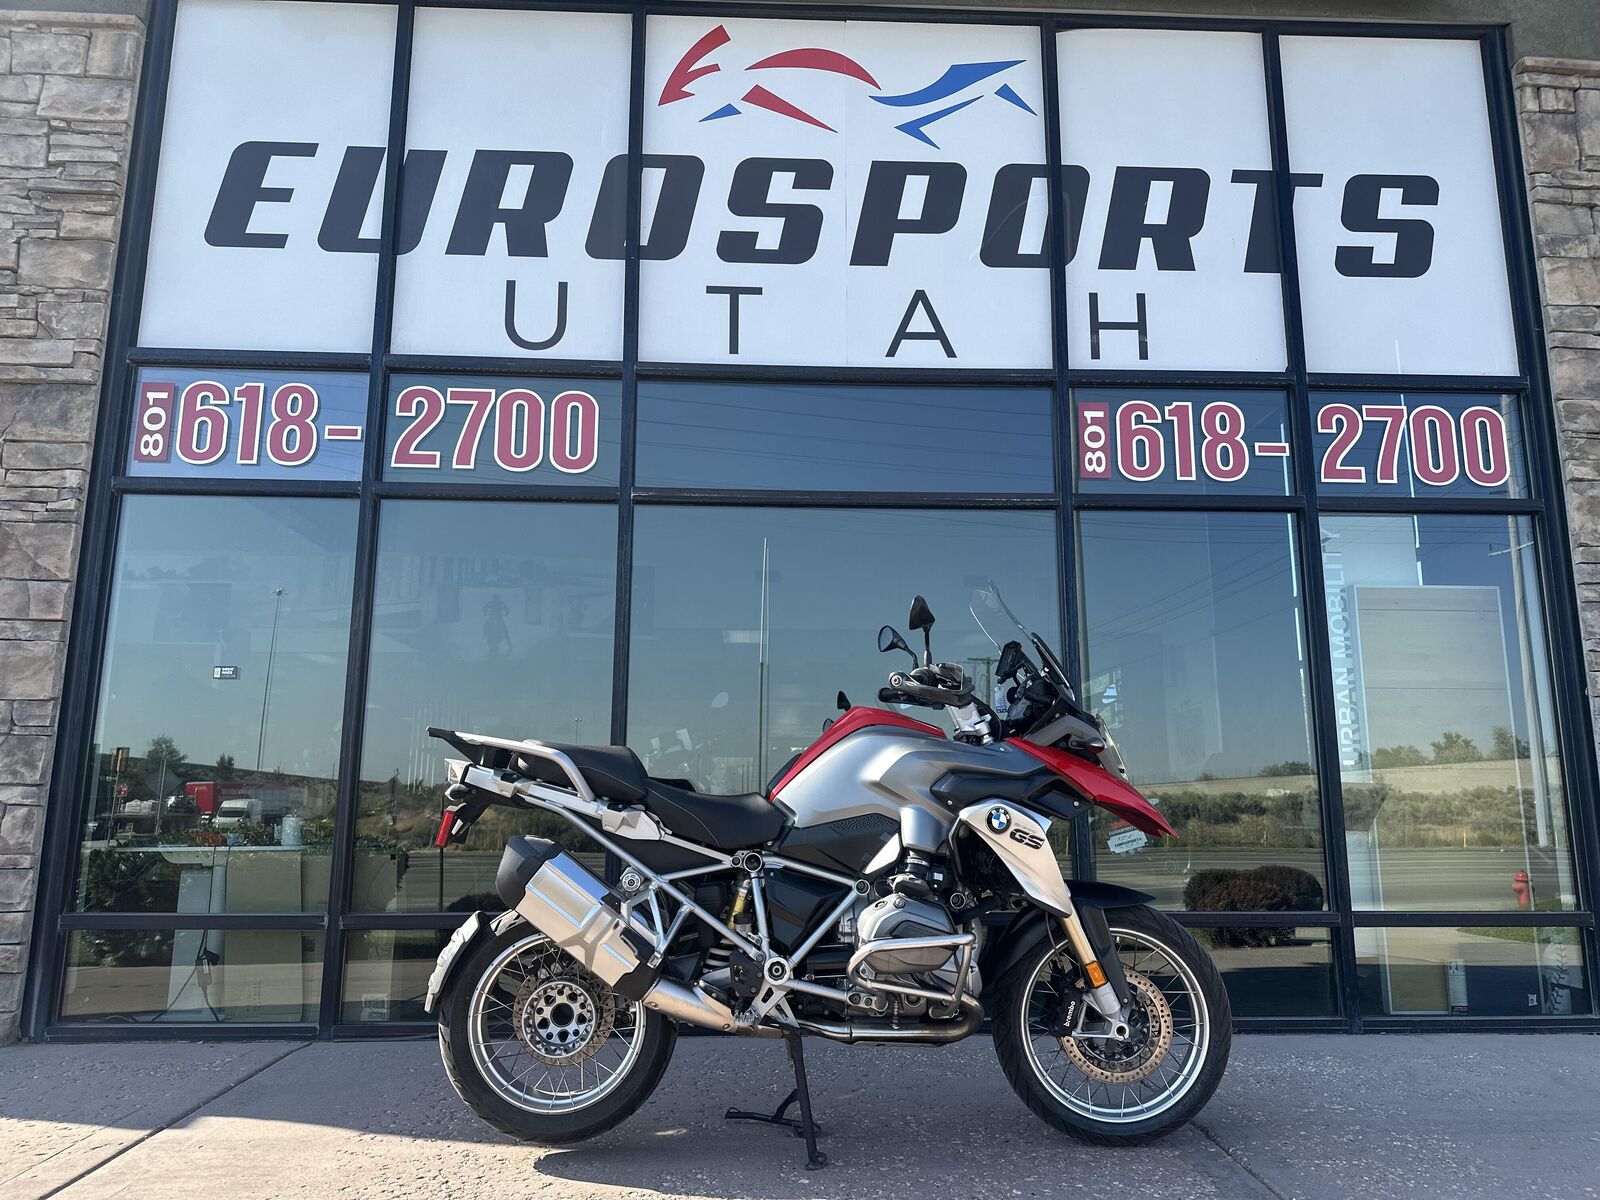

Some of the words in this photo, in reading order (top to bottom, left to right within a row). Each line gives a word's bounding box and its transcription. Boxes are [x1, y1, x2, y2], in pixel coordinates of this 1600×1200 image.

[204, 140, 1440, 278] EUROSPORTS
[504, 279, 1149, 361] UTAH
[140, 390, 168, 457] 801
[391, 385, 600, 474] 2700
[1083, 410, 1106, 474] 801
[1317, 403, 1511, 487] 2700
[1321, 528, 1352, 659] MOBILITY
[1334, 667, 1361, 767] URBAN
[1009, 828, 1046, 850] GS
[1063, 1000, 1076, 1027] brembo
